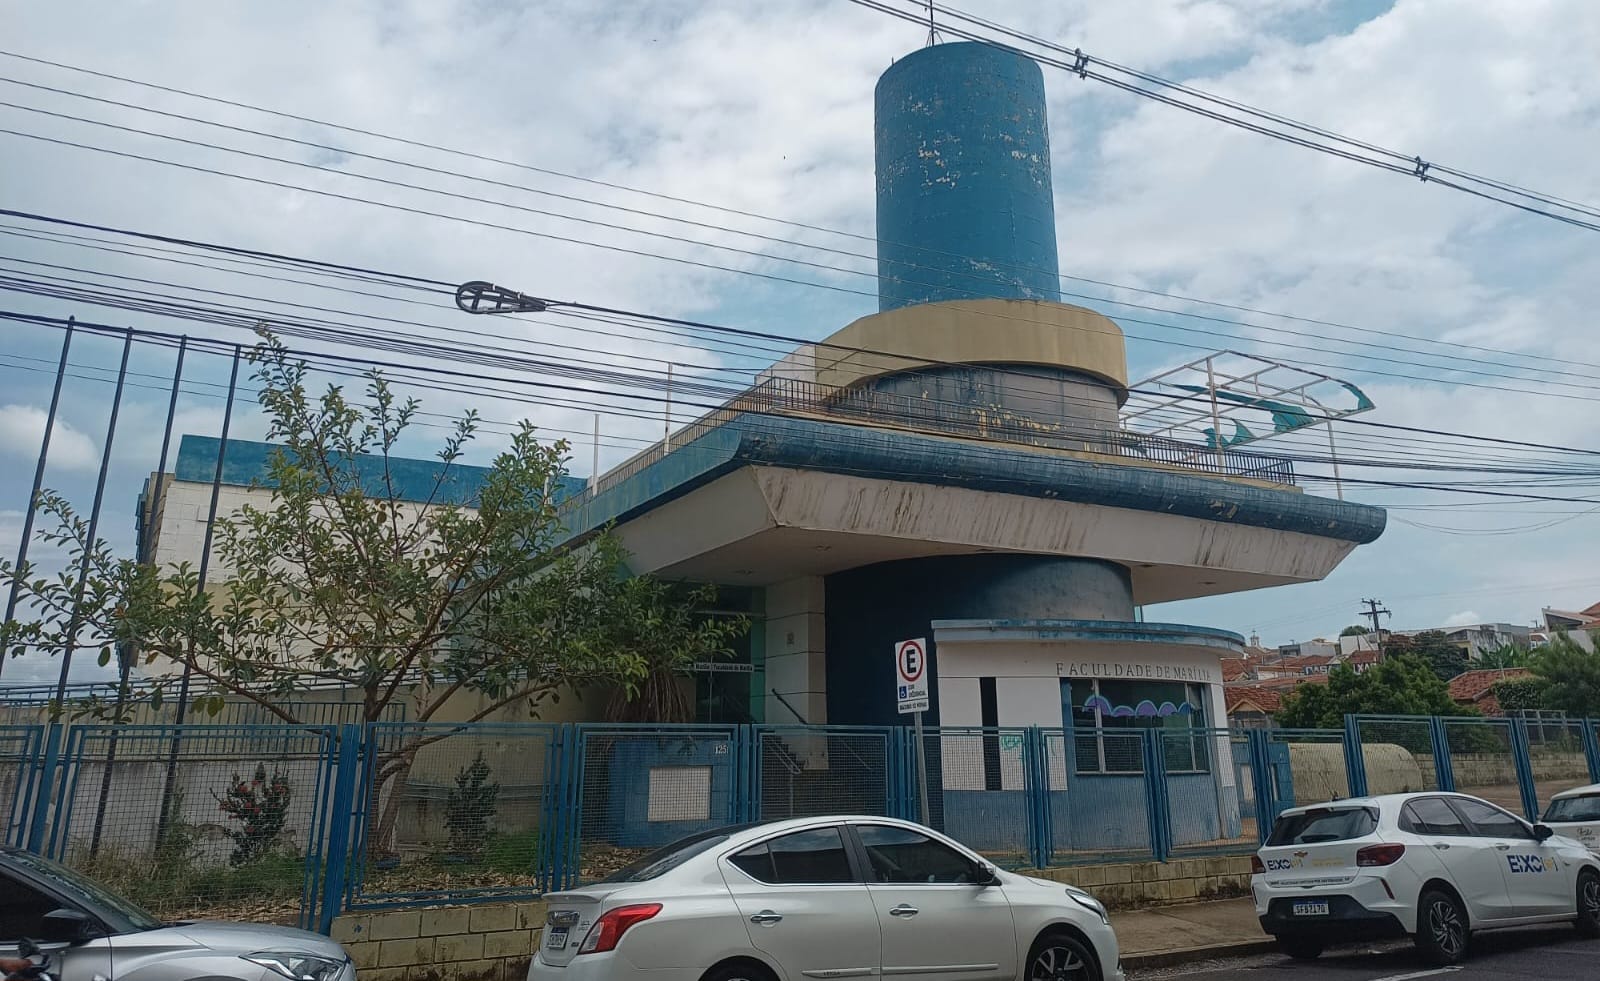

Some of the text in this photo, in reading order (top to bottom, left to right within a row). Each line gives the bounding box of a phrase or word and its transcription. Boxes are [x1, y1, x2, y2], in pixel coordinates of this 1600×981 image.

[906, 648, 917, 674] E
[1055, 662, 1152, 677] FACULDADE
[1156, 665, 1170, 679] DE
